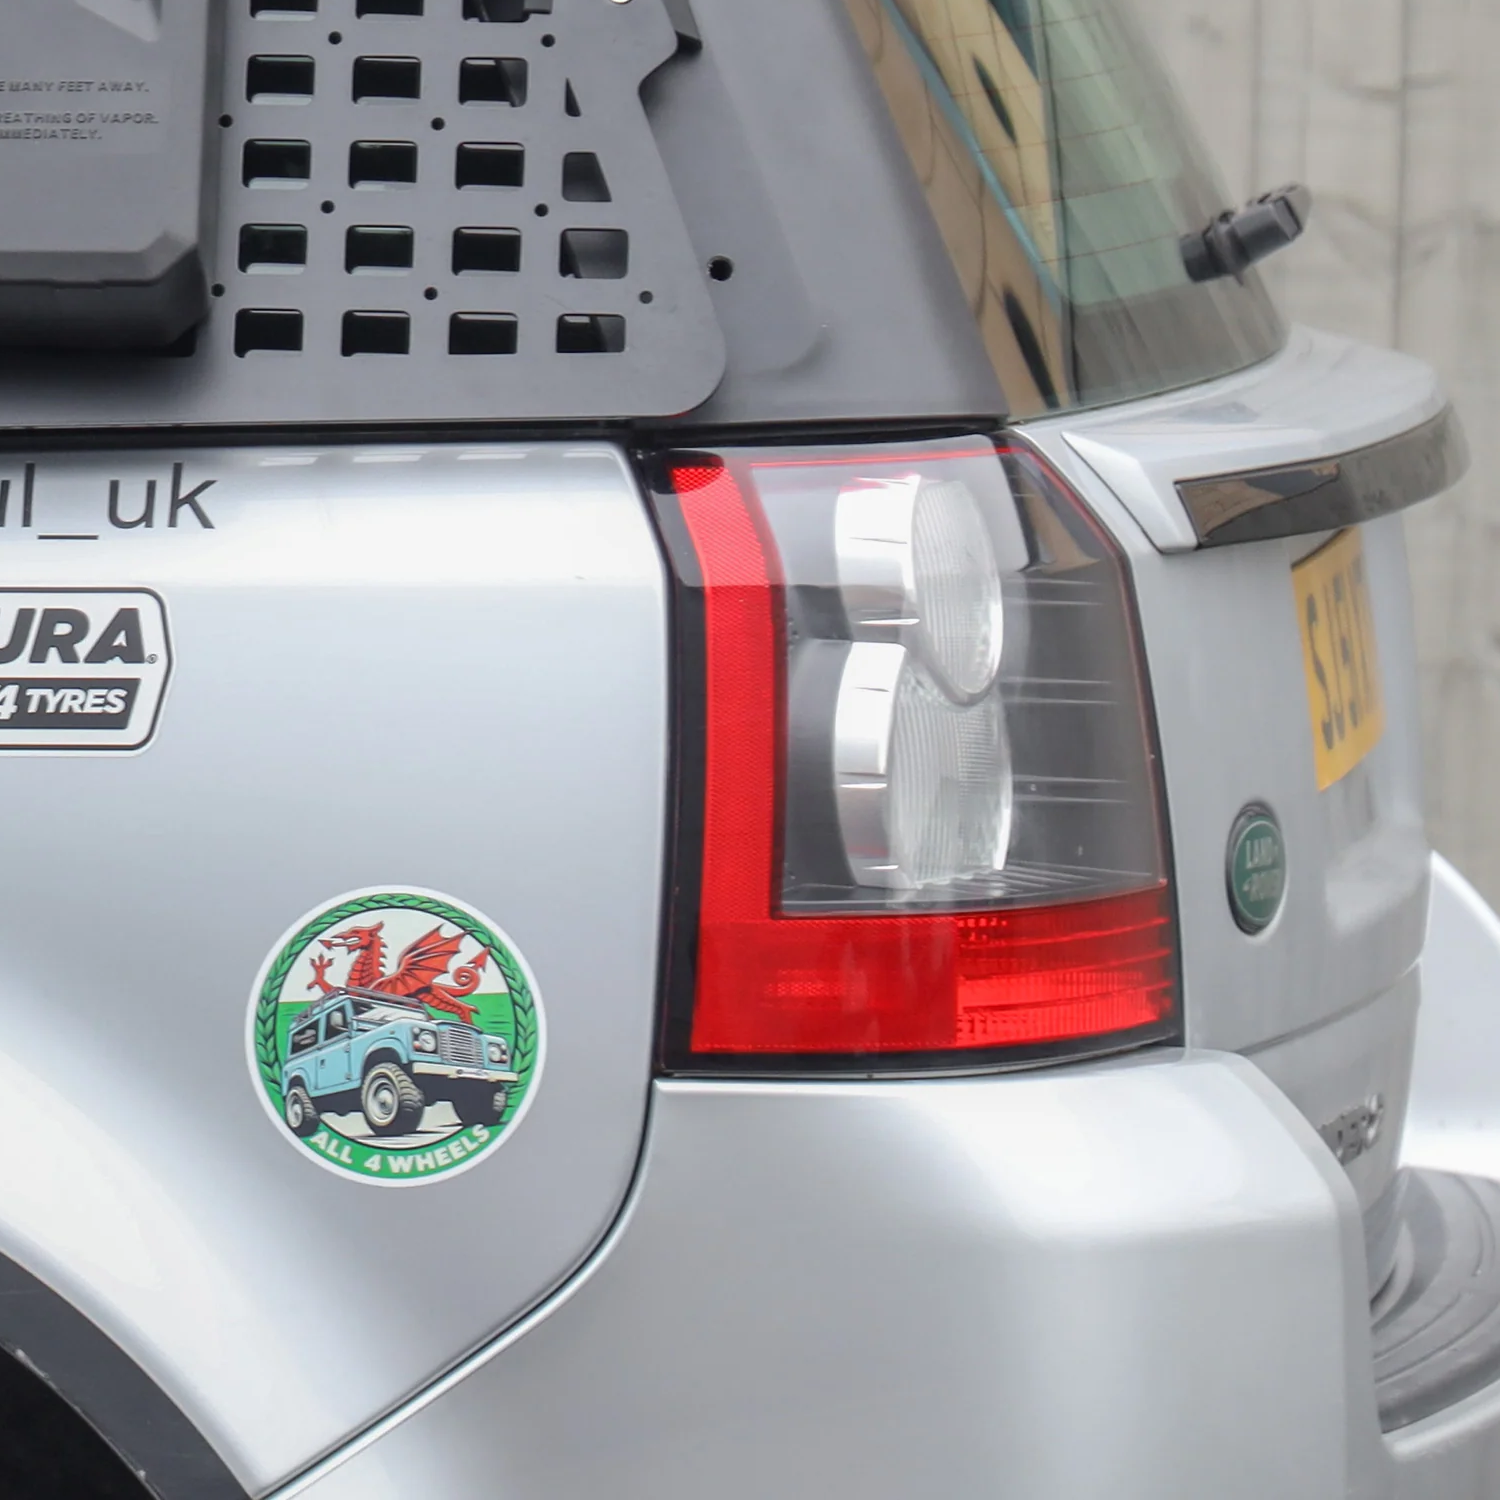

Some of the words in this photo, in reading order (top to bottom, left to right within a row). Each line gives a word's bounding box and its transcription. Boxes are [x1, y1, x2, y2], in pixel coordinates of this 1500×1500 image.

[9, 81, 54, 93] MANY
[58, 81, 95, 93] FEET
[76, 113, 96, 125] OF
[25, 687, 129, 714] TYRES
[309, 1131, 353, 1164] ALL
[363, 1154, 382, 1172] 4
[387, 1124, 491, 1174] WHEELS
